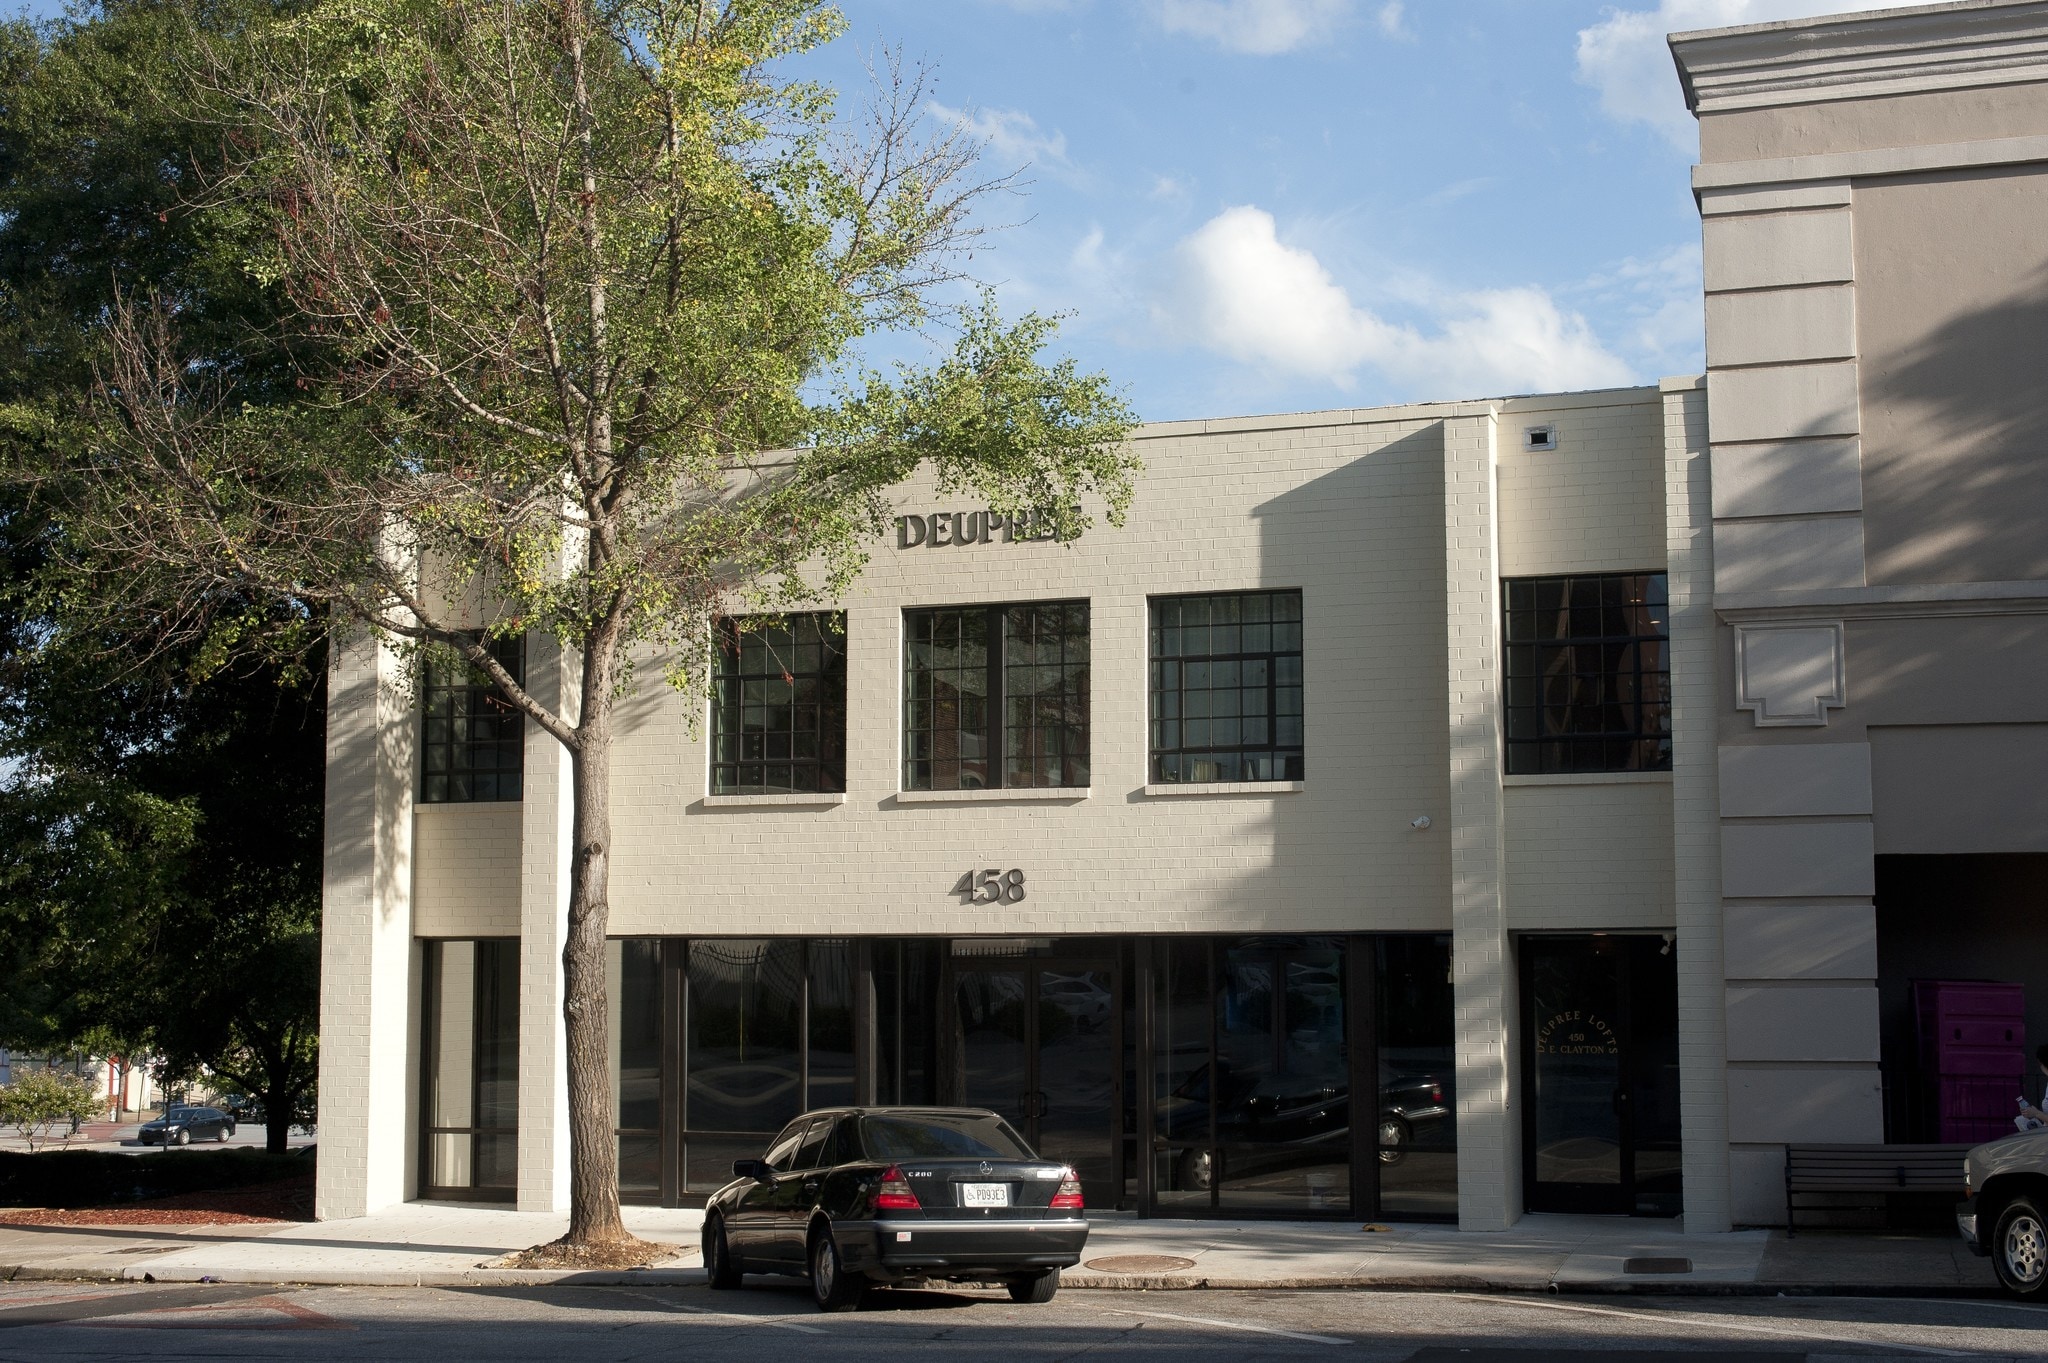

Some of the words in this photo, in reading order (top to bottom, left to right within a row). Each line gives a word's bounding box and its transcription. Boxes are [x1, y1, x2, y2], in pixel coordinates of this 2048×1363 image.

[901, 505, 1082, 548] DEUPRE
[956, 868, 1025, 902] 458
[1536, 1010, 1581, 1053] DEUPREE
[1588, 1014, 1618, 1054] LOFTS
[1568, 1033, 1585, 1042] 450
[1561, 1045, 1604, 1054] CLAYTON
